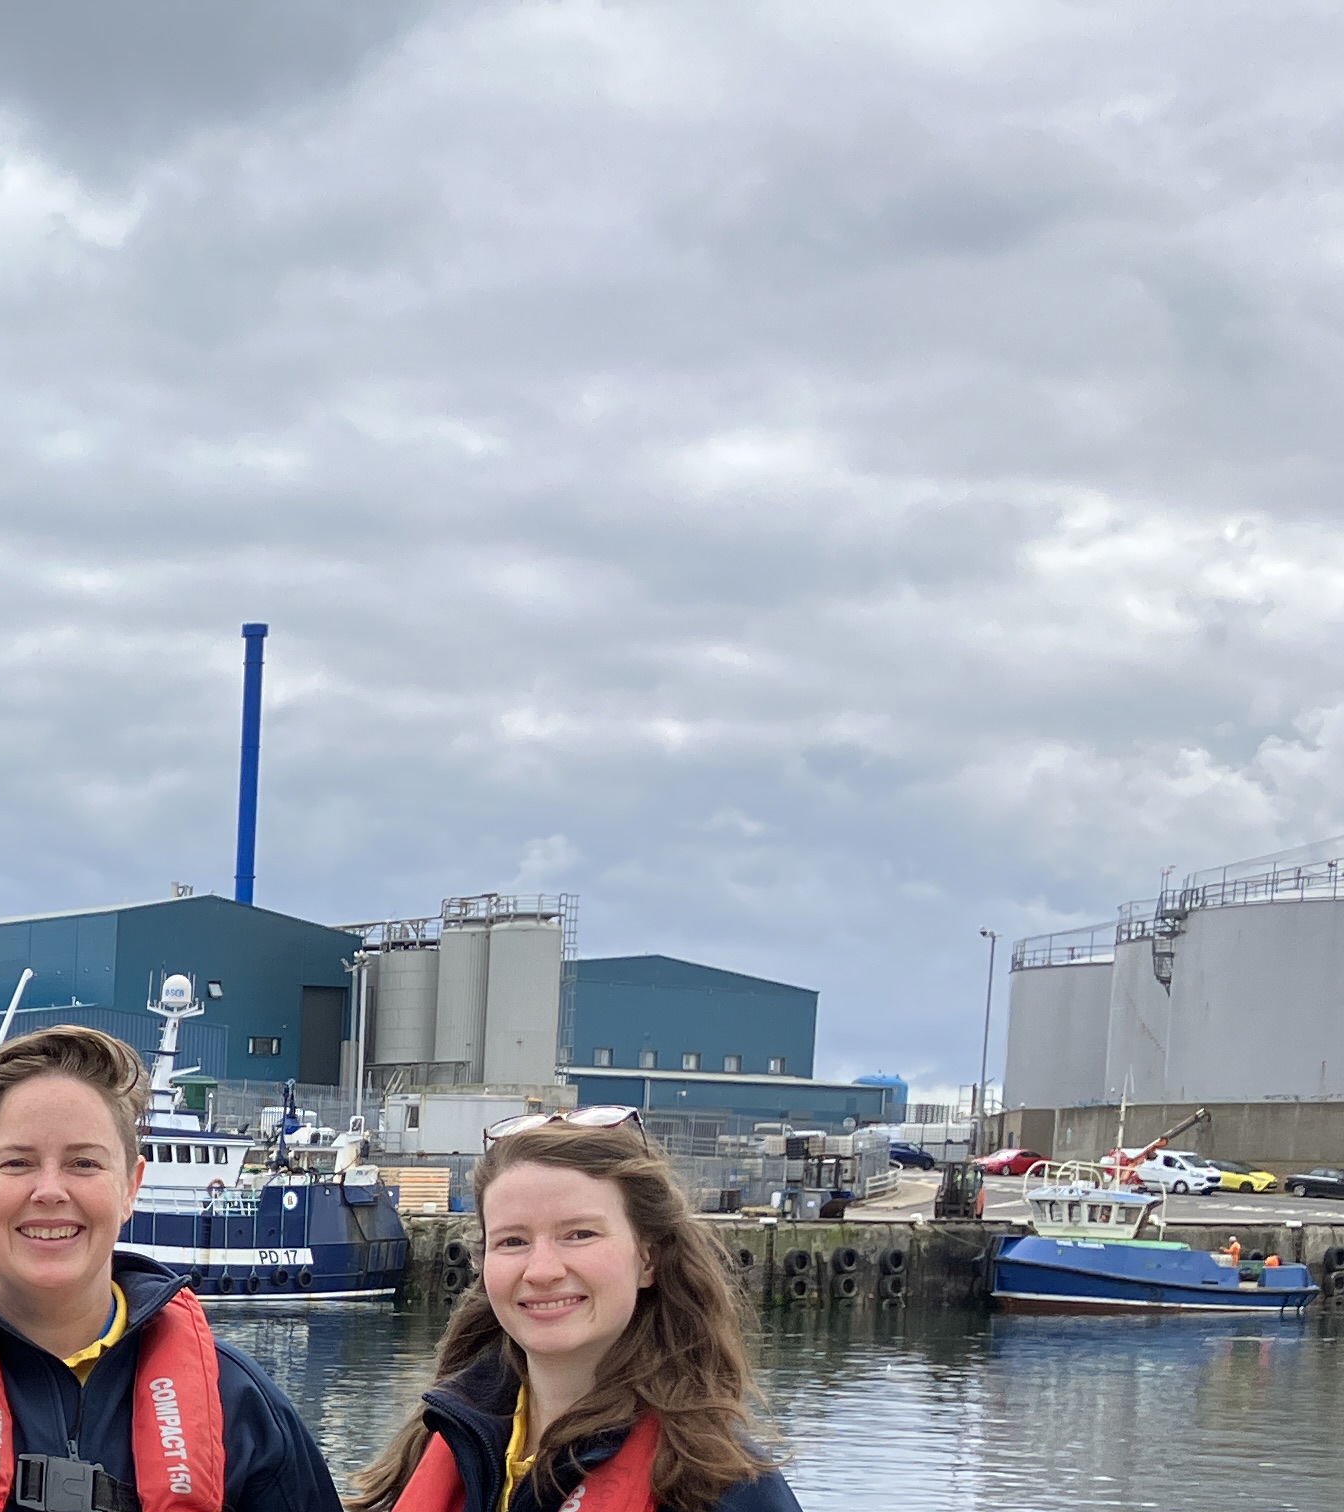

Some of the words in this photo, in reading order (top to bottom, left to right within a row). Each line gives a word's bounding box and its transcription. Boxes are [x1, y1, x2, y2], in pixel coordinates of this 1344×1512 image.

[259, 1250, 279, 1264] PD
[284, 1250, 297, 1264] 17
[149, 1377, 188, 1460] COMPACT
[167, 1463, 192, 1495] 150
